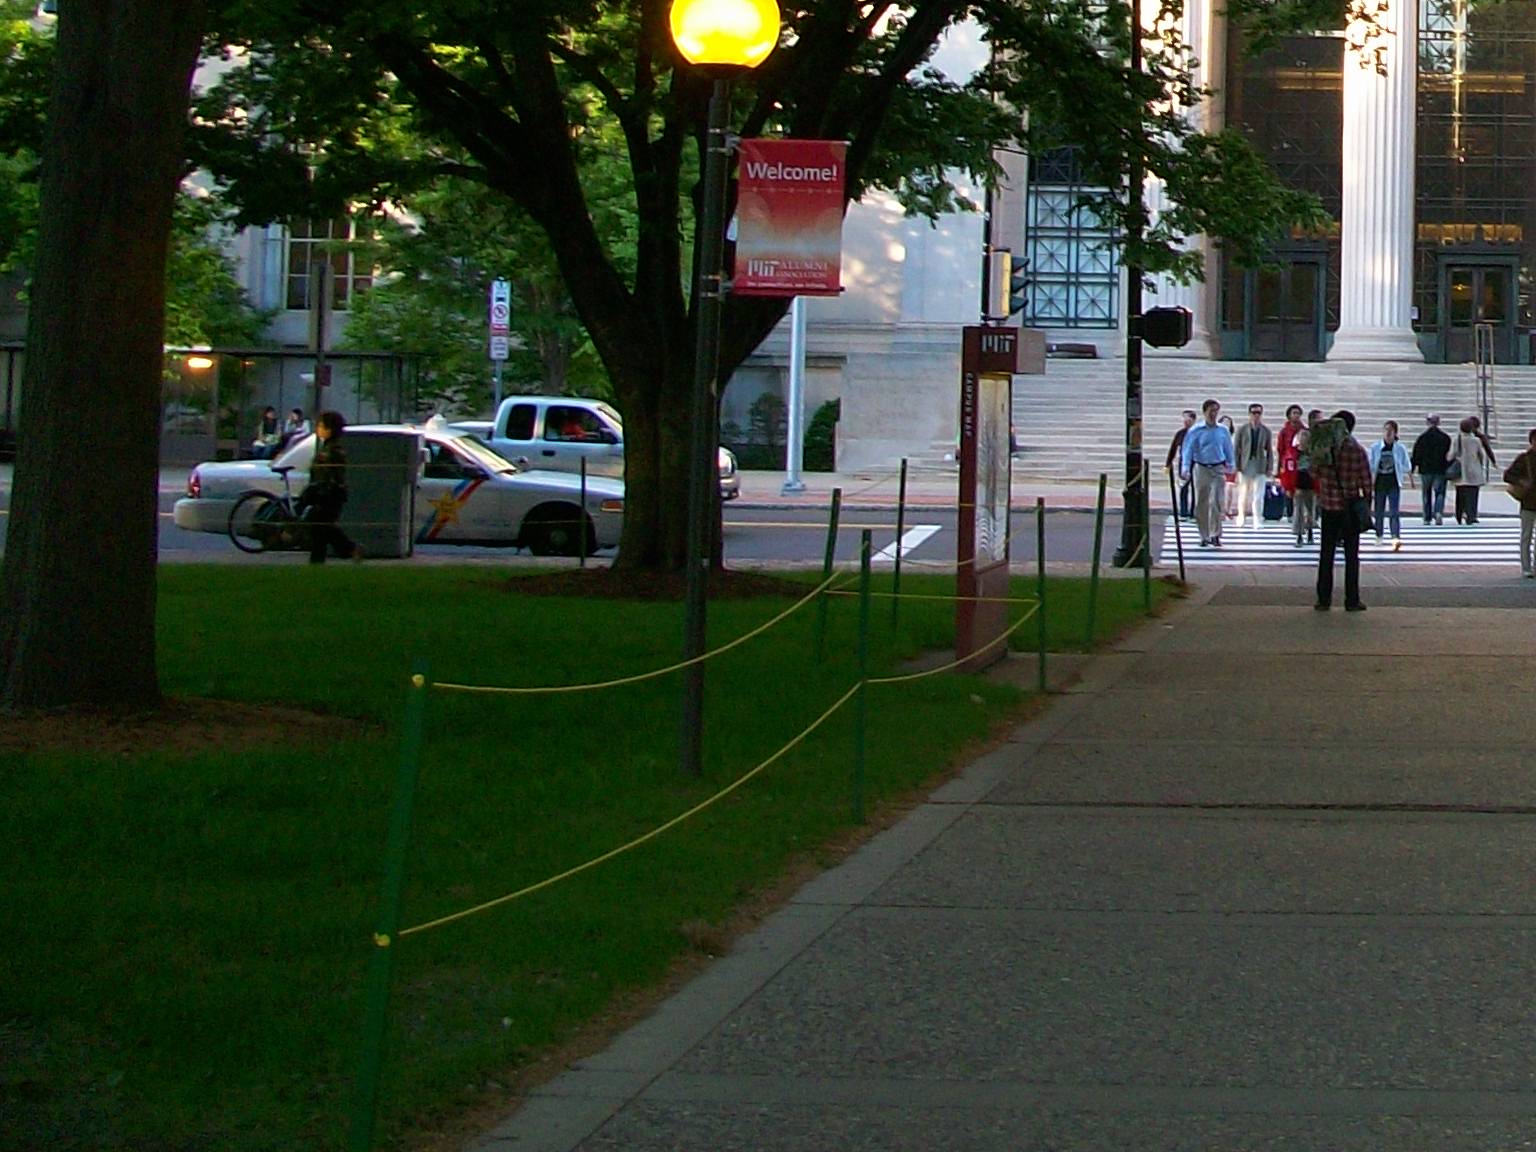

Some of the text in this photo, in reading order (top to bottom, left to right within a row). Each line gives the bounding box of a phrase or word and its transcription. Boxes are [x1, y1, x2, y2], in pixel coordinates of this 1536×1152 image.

[747, 162, 837, 181] Welcome!
[982, 335, 1015, 352] MIT
[966, 373, 974, 412] CAMPUS
